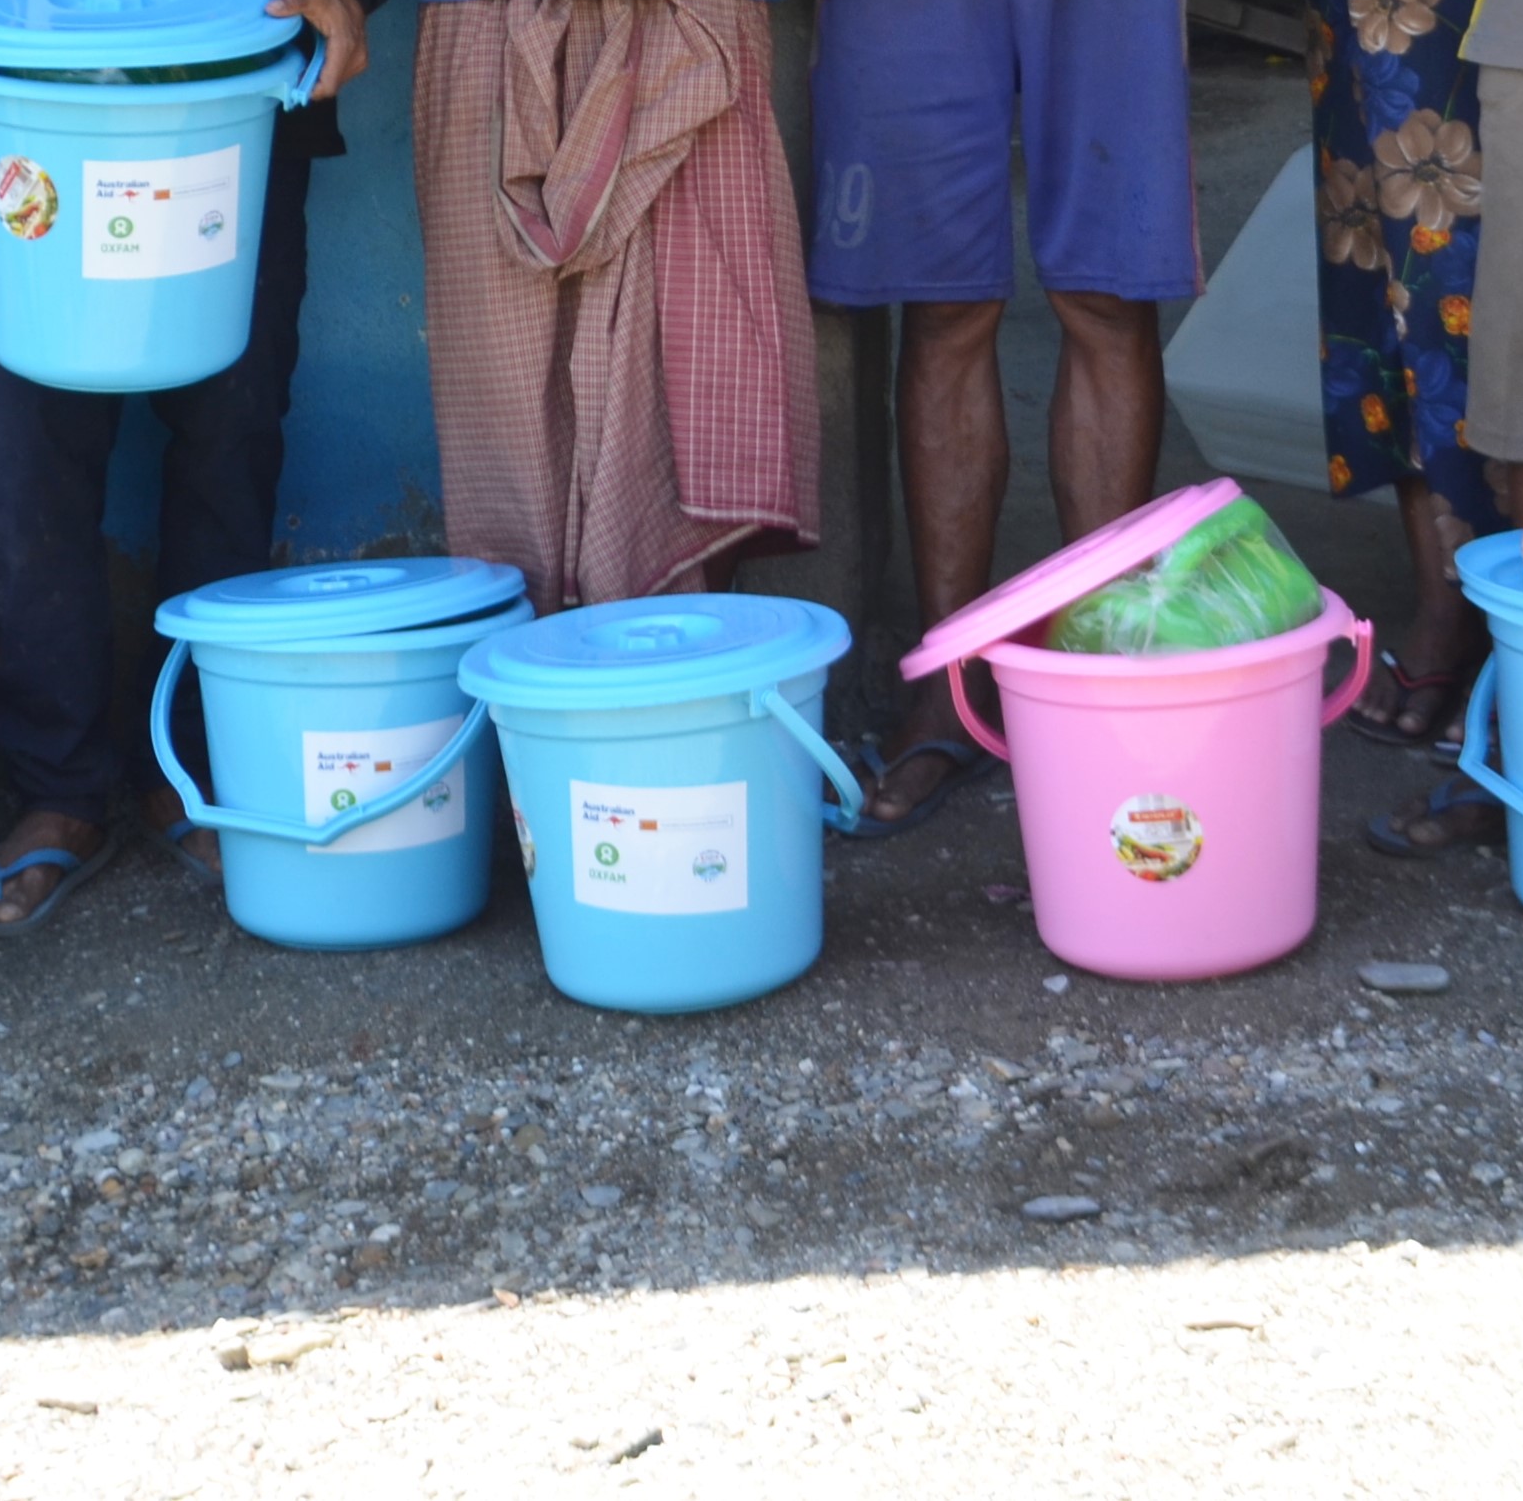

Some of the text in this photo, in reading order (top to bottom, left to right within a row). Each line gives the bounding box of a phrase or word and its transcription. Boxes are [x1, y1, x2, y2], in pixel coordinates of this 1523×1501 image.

[96, 179, 150, 189] Australian
[96, 189, 115, 198] Aid
[100, 243, 140, 253] OXFAM
[317, 751, 371, 761] Australian
[582, 800, 636, 816] Australian
[582, 812, 600, 823] Aid
[588, 867, 628, 884] OXFAM
